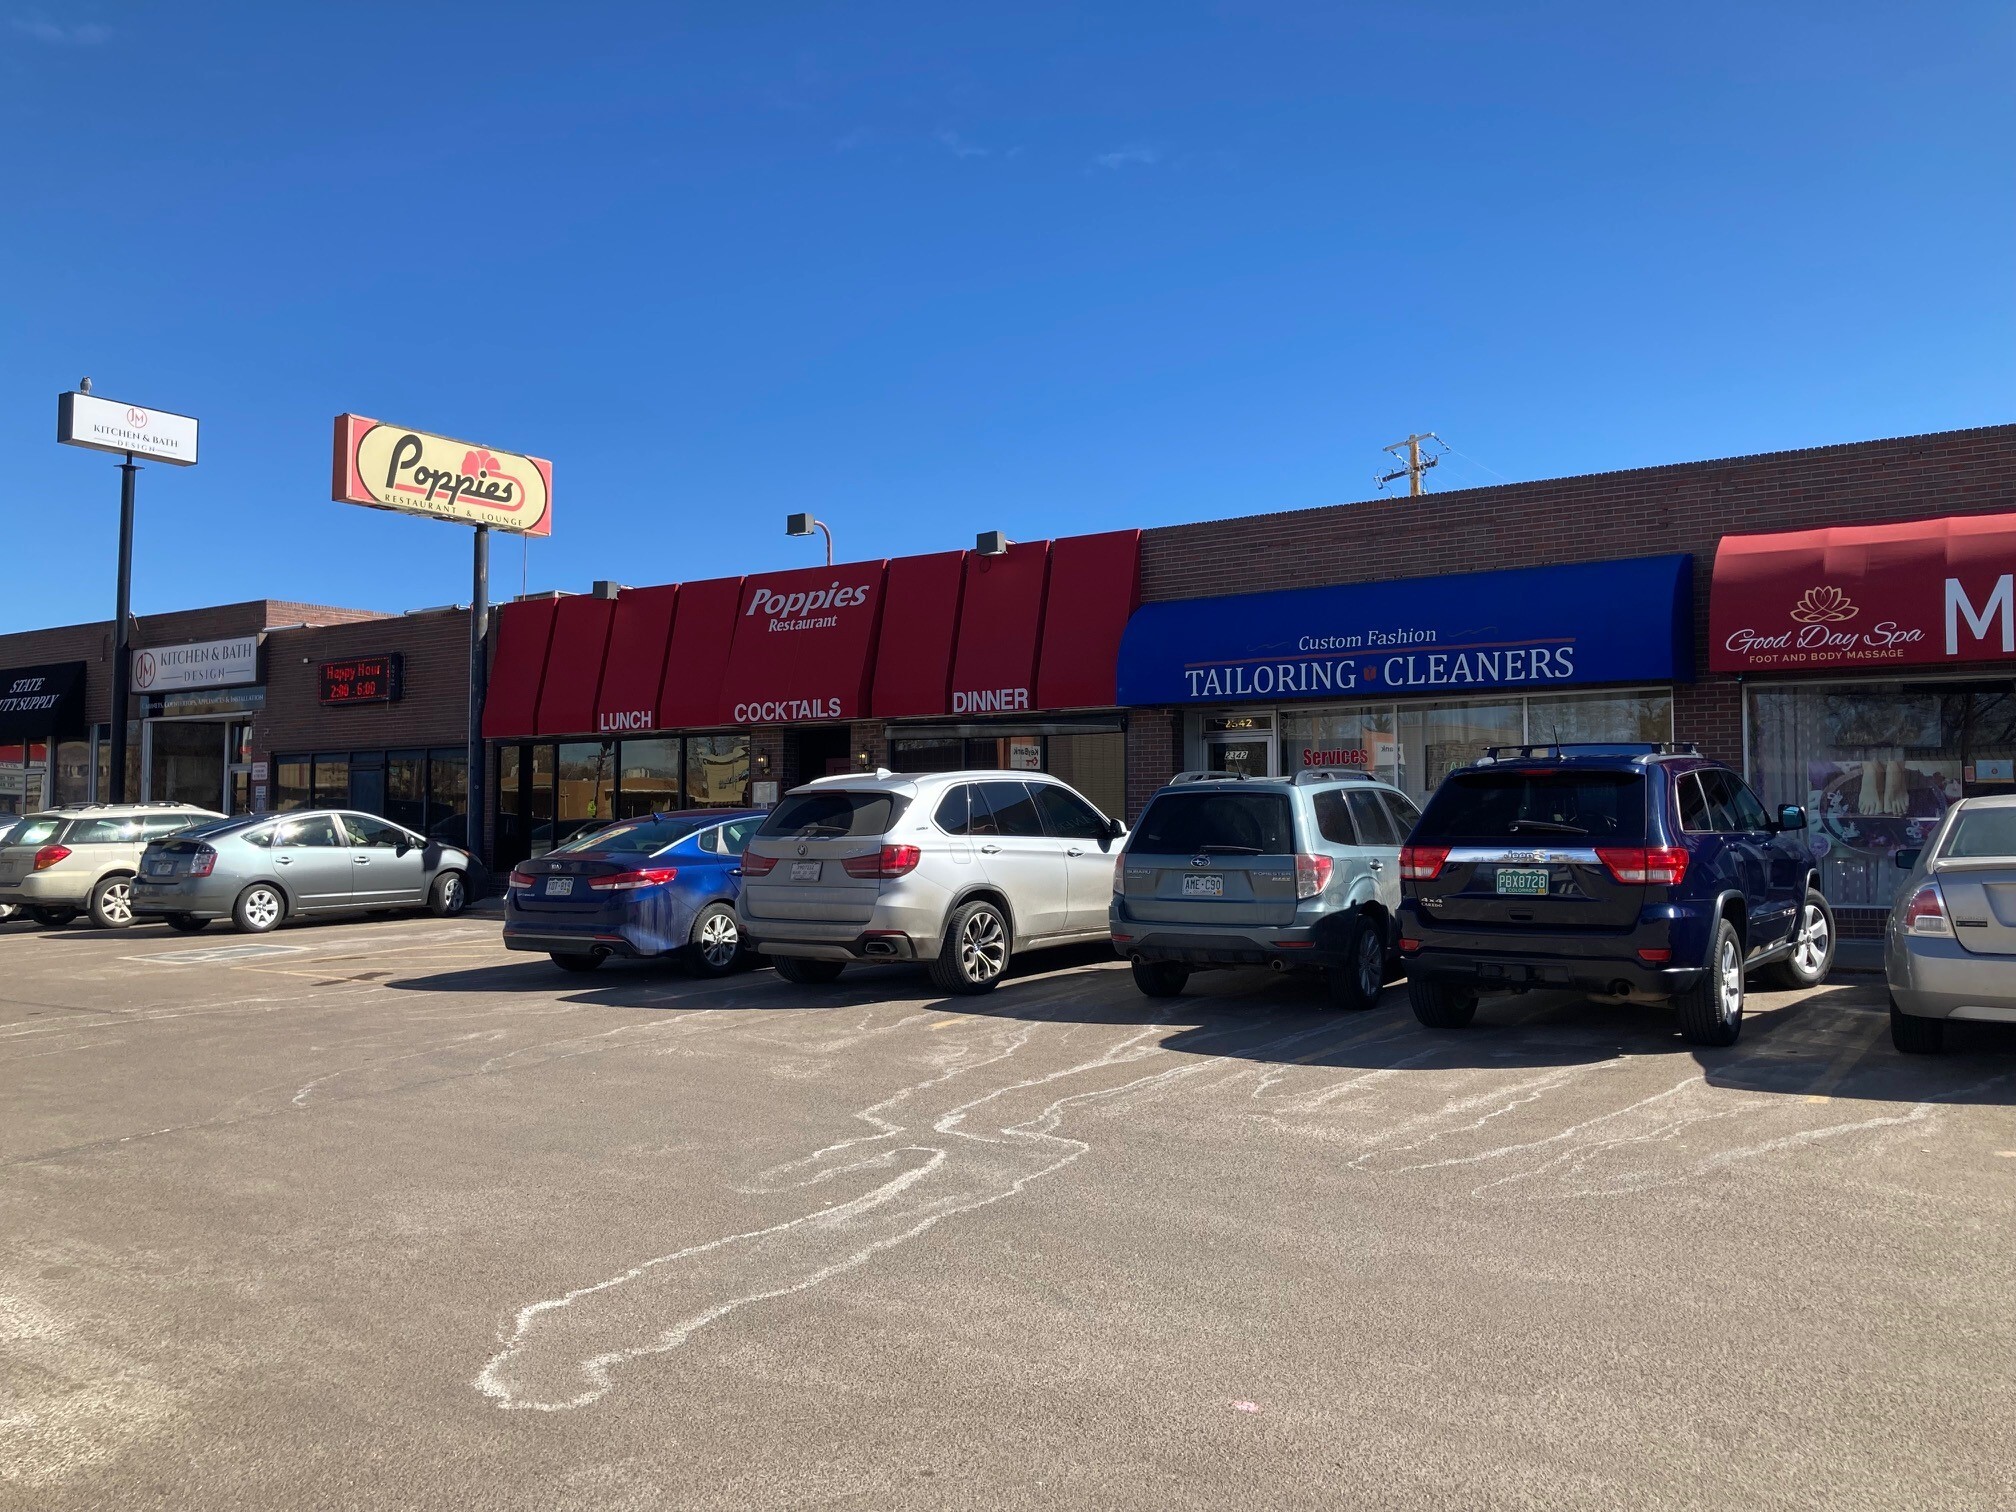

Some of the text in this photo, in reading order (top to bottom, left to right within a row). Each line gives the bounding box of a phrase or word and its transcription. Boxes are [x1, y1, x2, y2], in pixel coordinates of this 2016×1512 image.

[93, 424, 179, 448] KITCHEN & BATH
[117, 439, 156, 452] DESIGN
[385, 434, 514, 506] Poppies
[385, 493, 523, 527] RESTAURANT & LOUNGE
[746, 581, 871, 618] Poppies
[768, 614, 838, 632] Restaurant
[1298, 627, 1438, 652] Custom Fashion
[1725, 621, 1926, 655] Good Day Spa
[160, 643, 252, 666] KITCHEN & BATH
[1749, 649, 1904, 664] FOOT AND BODY MASSAGE
[184, 667, 226, 683] DESIGN
[326, 666, 356, 682] Happy
[358, 663, 381, 677] Hour
[1185, 646, 1575, 698] TAILORING CLEANERS
[9, 677, 45, 693] STATE
[357, 681, 377, 696] 6:00
[17, 694, 60, 710] SUPPLY
[734, 697, 842, 723] COCKTAILS
[953, 688, 1029, 713] DINNER
[600, 710, 652, 731] LUNCH
[1303, 746, 1369, 767] Services
[1503, 850, 1534, 861] Jeep
[1499, 875, 1546, 889] PBX8728
